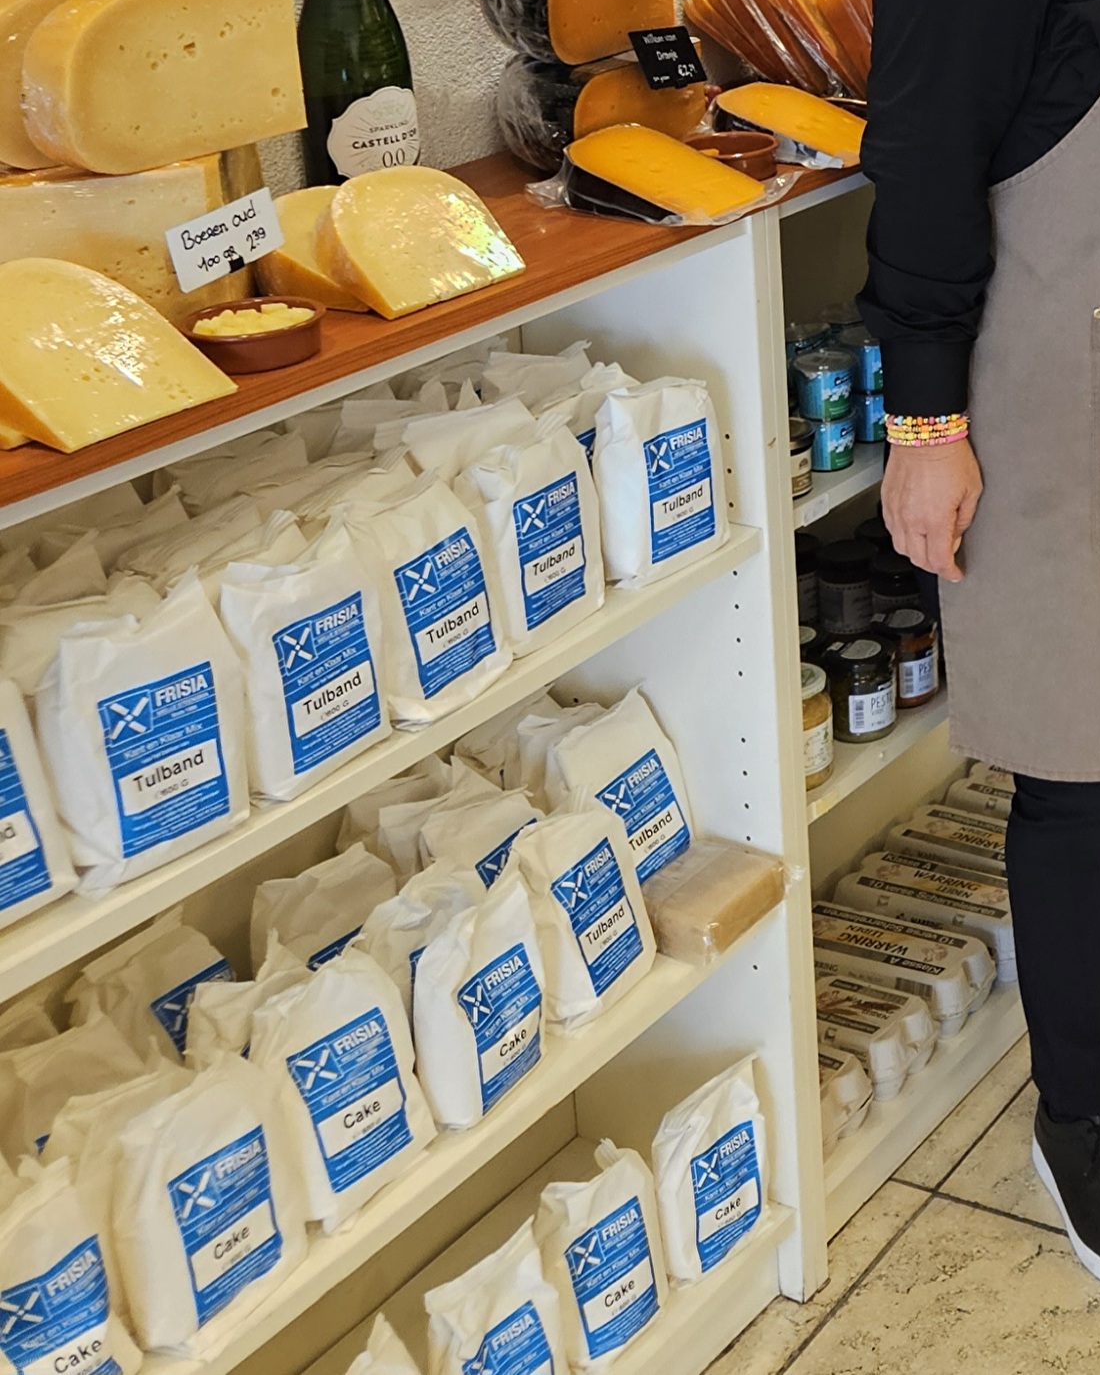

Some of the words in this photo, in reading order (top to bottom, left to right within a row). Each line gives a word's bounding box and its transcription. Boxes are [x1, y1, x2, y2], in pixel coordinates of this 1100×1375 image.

[352, 135, 400, 149] CASTELL
[181, 223, 229, 250] Boeren
[232, 199, 256, 227] oud
[198, 255, 220, 271] 100
[669, 427, 703, 450] FRISIA
[548, 481, 575, 507] FRISIA
[662, 485, 703, 514] Tulband
[434, 538, 470, 569] FRISIA
[532, 543, 575, 575] Tulband
[315, 604, 358, 635] FRISIA
[426, 602, 480, 644] Tulband
[155, 674, 208, 706] FRISIA
[303, 672, 362, 715] Tulband
[133, 749, 204, 791] Tulband
[627, 759, 659, 788] FRISIA
[628, 810, 673, 851] Tulband
[584, 847, 612, 877] FRISIA
[869, 880, 883, 888] 10
[914, 870, 981, 891] WARRING
[935, 886, 973, 899] LEIDEN
[585, 905, 625, 945] Tulband
[847, 925, 883, 938] LEIDEN
[905, 926, 938, 942] verse
[837, 932, 908, 956] WARRING
[939, 936, 954, 946] 10
[484, 955, 524, 991] FRISIA
[902, 959, 942, 975] Klasse
[333, 1020, 383, 1055] FRISIA
[500, 1029, 527, 1057] Cake
[343, 1099, 381, 1129] Cake
[214, 1139, 262, 1179] FRISIA
[720, 1130, 750, 1158] FRISIA
[715, 1197, 741, 1221] Cake
[601, 1209, 639, 1241] FRISIA
[214, 1225, 250, 1260] Cake
[46, 1249, 98, 1297] FRISIA
[604, 1279, 635, 1308] Cake
[491, 1313, 535, 1351] FRISIA
[54, 1340, 102, 1373] Cake
